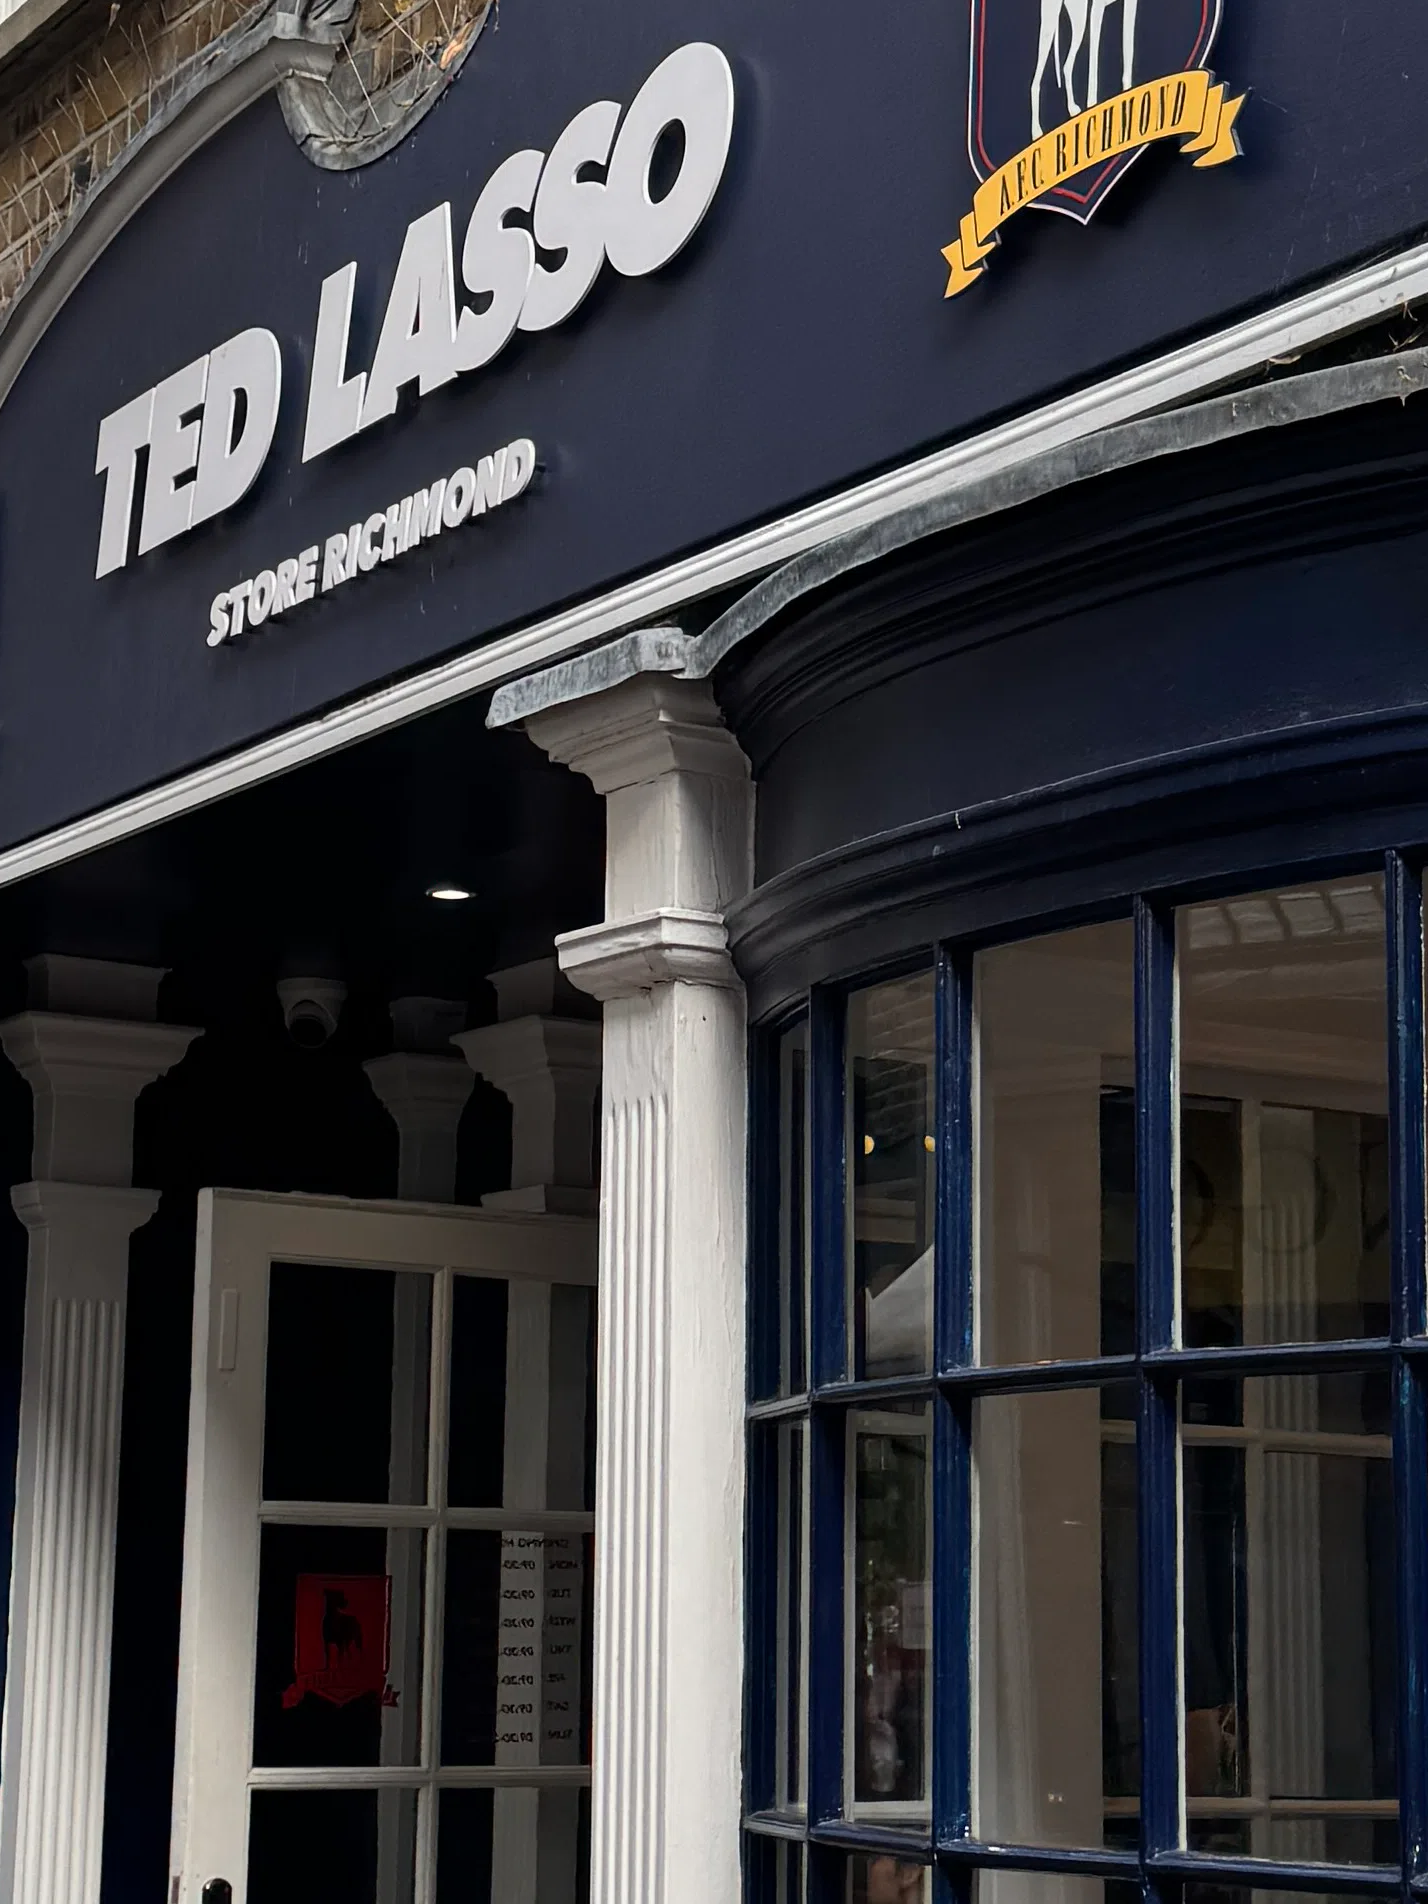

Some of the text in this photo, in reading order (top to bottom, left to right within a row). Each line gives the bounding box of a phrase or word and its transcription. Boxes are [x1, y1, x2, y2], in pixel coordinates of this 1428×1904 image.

[999, 80, 1187, 216] A.F.C. RICHMOND
[95, 41, 734, 581] TED LASSO
[206, 438, 536, 647] STORE RICHMOND
